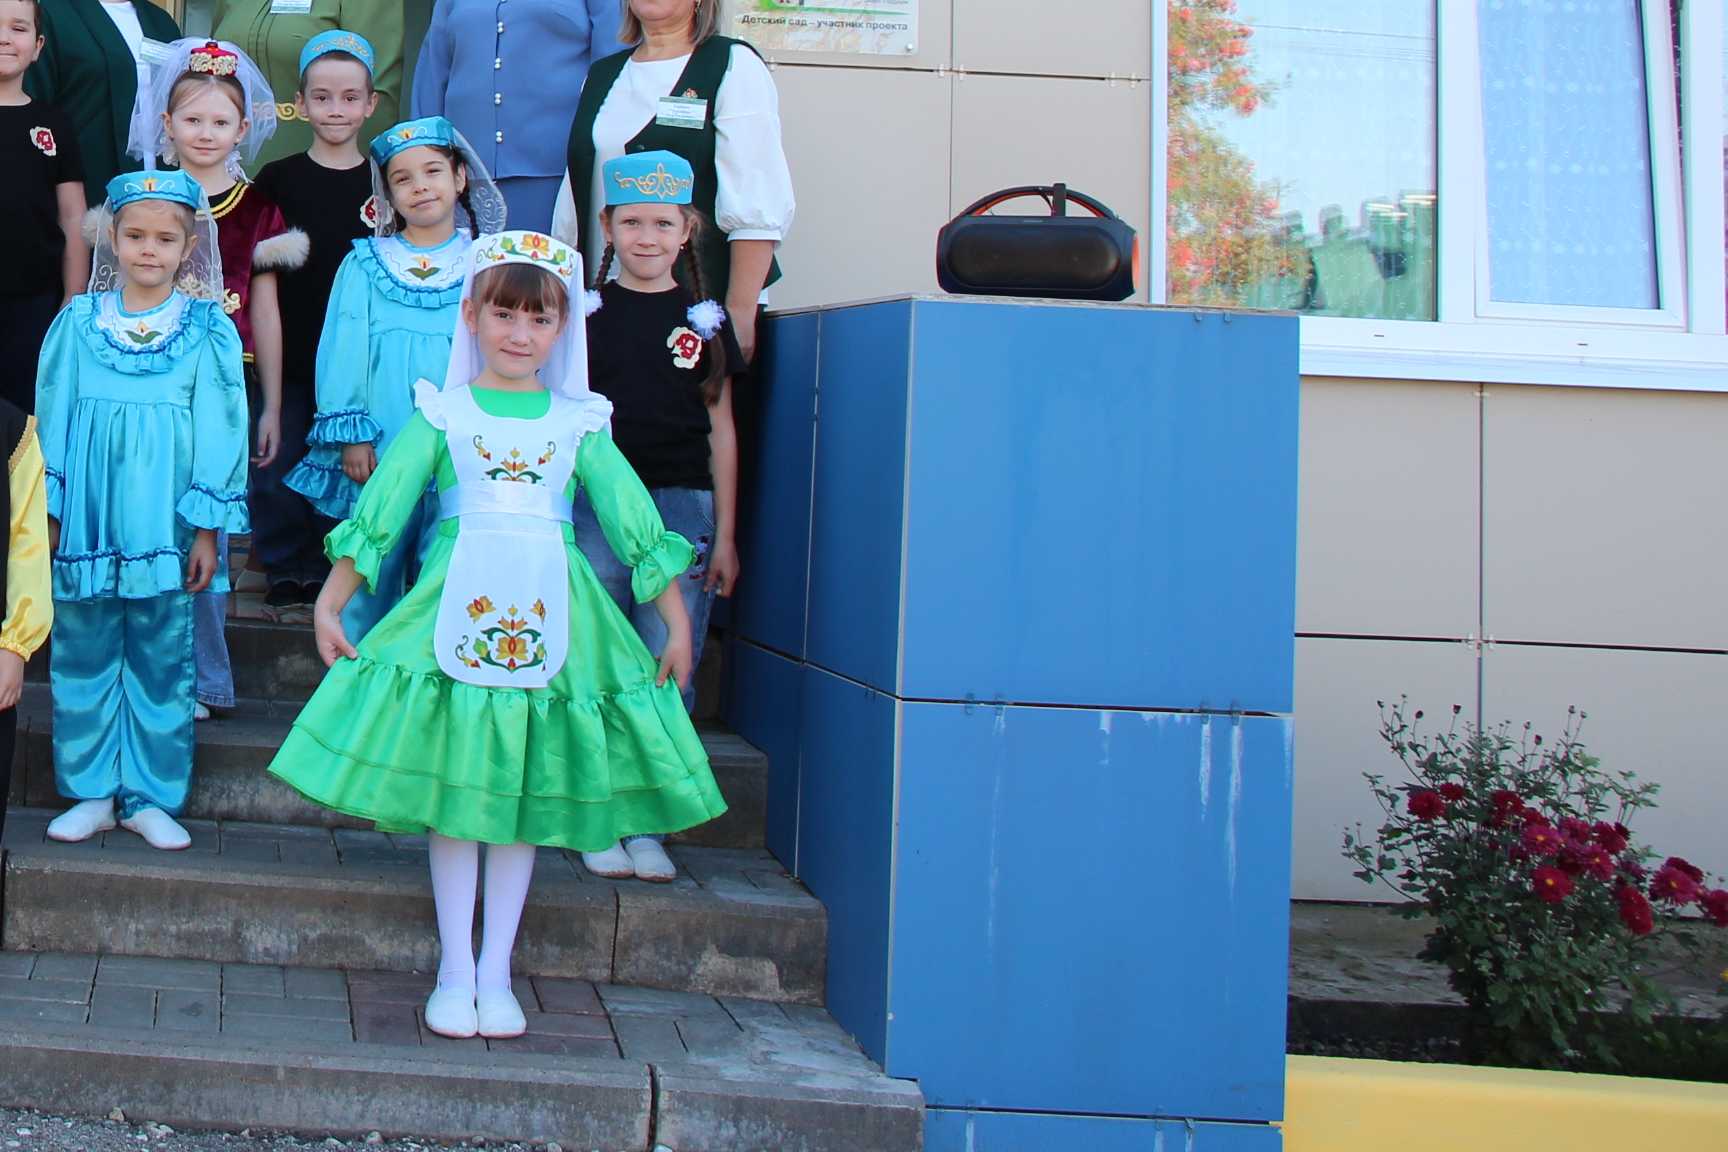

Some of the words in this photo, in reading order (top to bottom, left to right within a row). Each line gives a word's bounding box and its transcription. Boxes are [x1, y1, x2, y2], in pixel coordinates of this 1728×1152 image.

[742, 15, 786, 25] Детский
[788, 18, 808, 27] сад
[817, 20, 863, 28] участник
